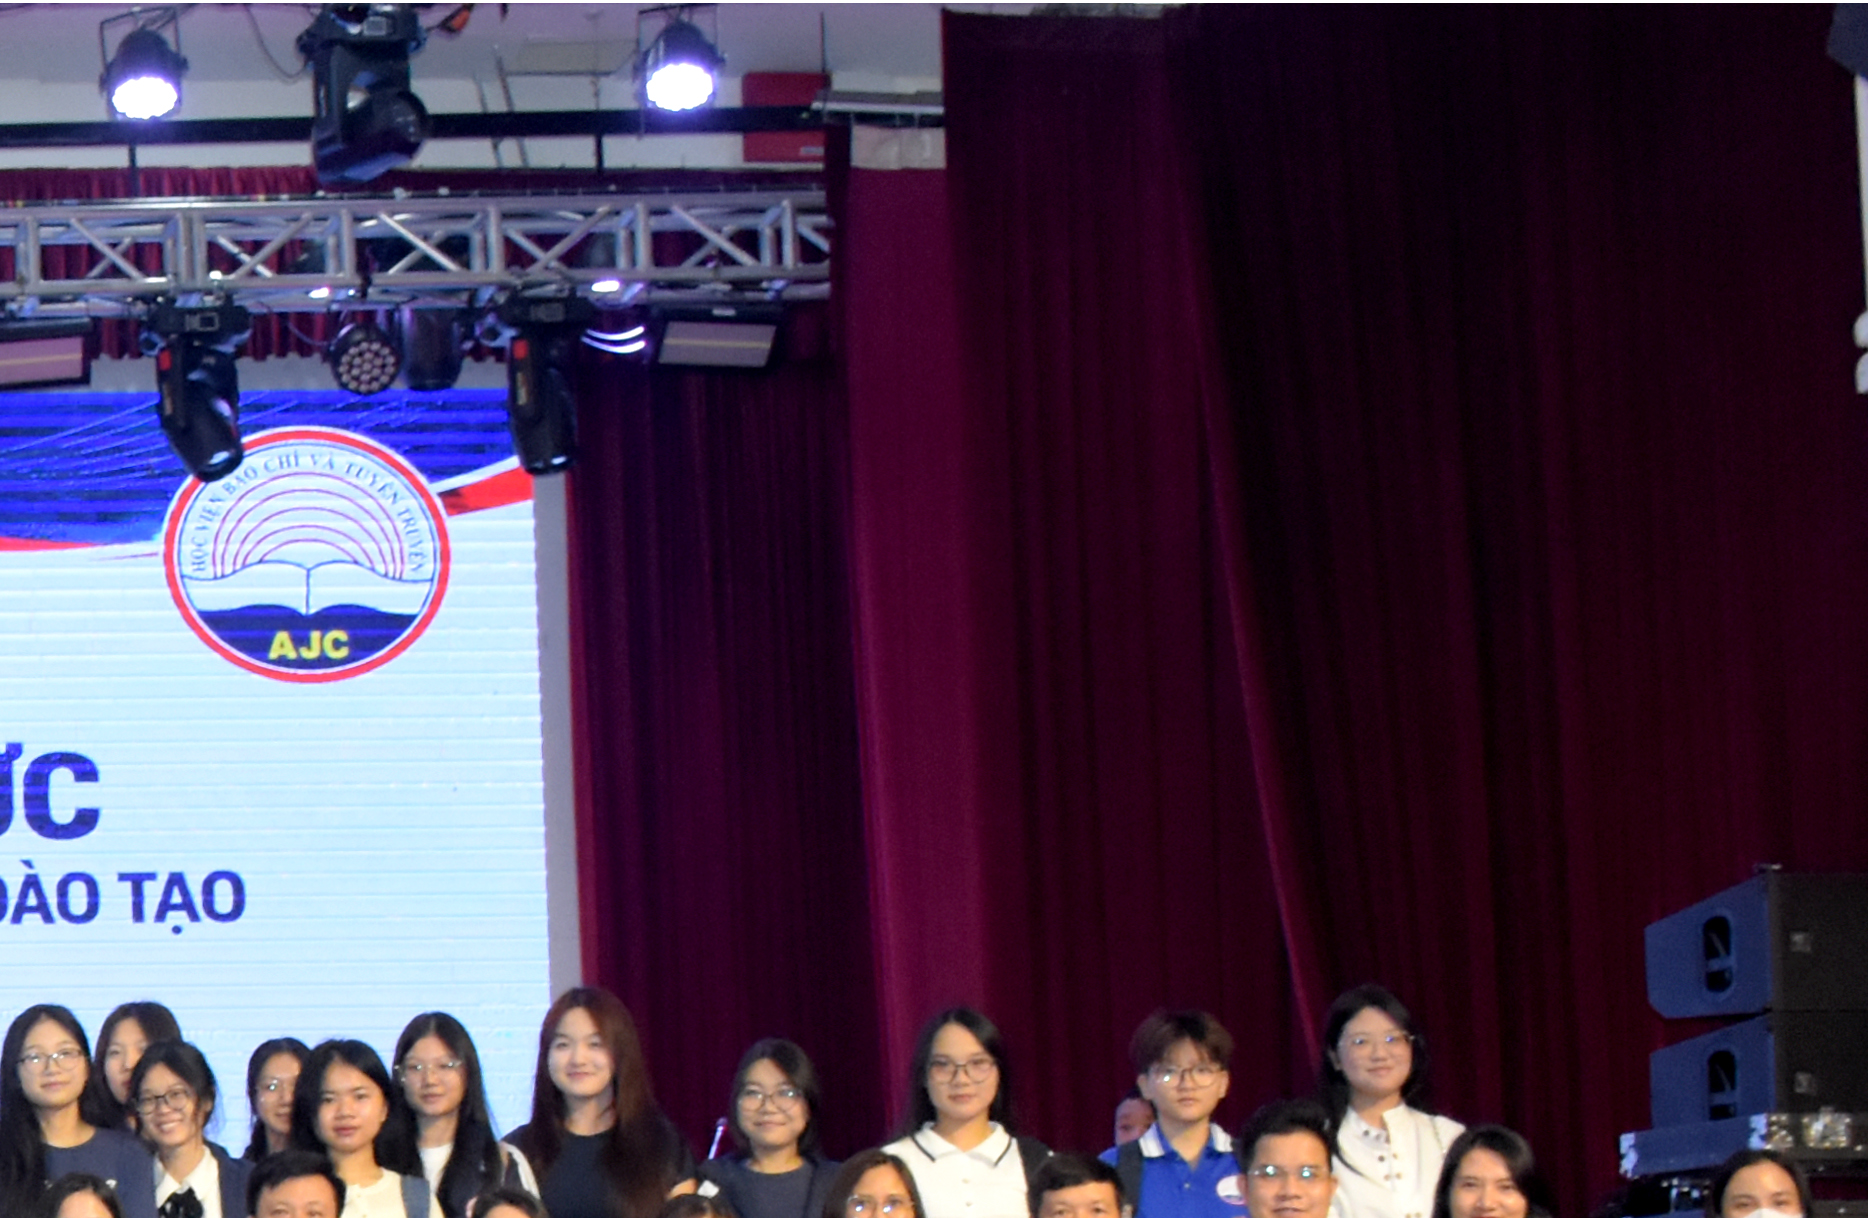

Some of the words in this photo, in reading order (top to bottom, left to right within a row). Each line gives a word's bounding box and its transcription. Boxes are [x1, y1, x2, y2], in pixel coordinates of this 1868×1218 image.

[263, 449, 300, 472] CHÍ
[309, 453, 336, 472] VÀ
[268, 630, 349, 660] AJC
[118, 871, 247, 935] TẠO
